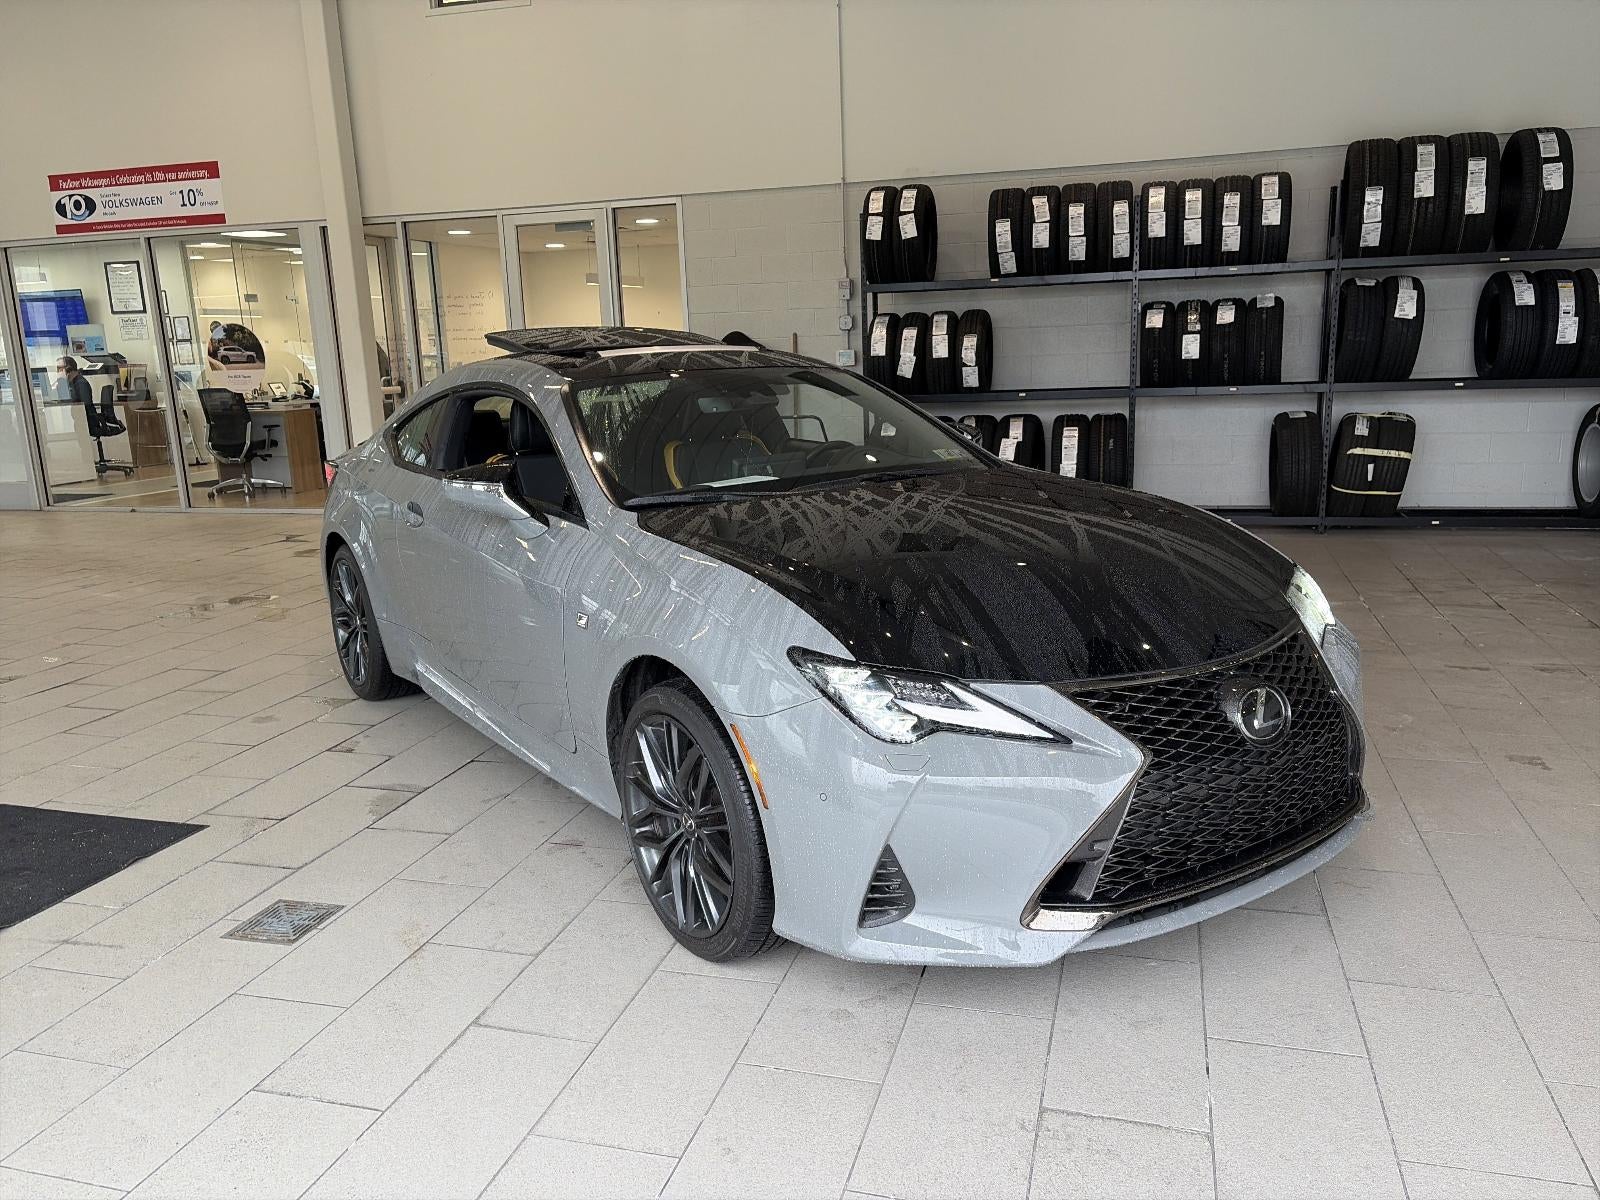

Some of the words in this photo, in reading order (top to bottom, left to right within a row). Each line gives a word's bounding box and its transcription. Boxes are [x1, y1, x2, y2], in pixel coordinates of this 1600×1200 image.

[115, 172, 145, 185] Celebrating
[152, 170, 165, 181] 10th
[165, 171, 177, 183] year
[60, 194, 86, 219] 10
[100, 195, 163, 210] VOLKSWAGEN
